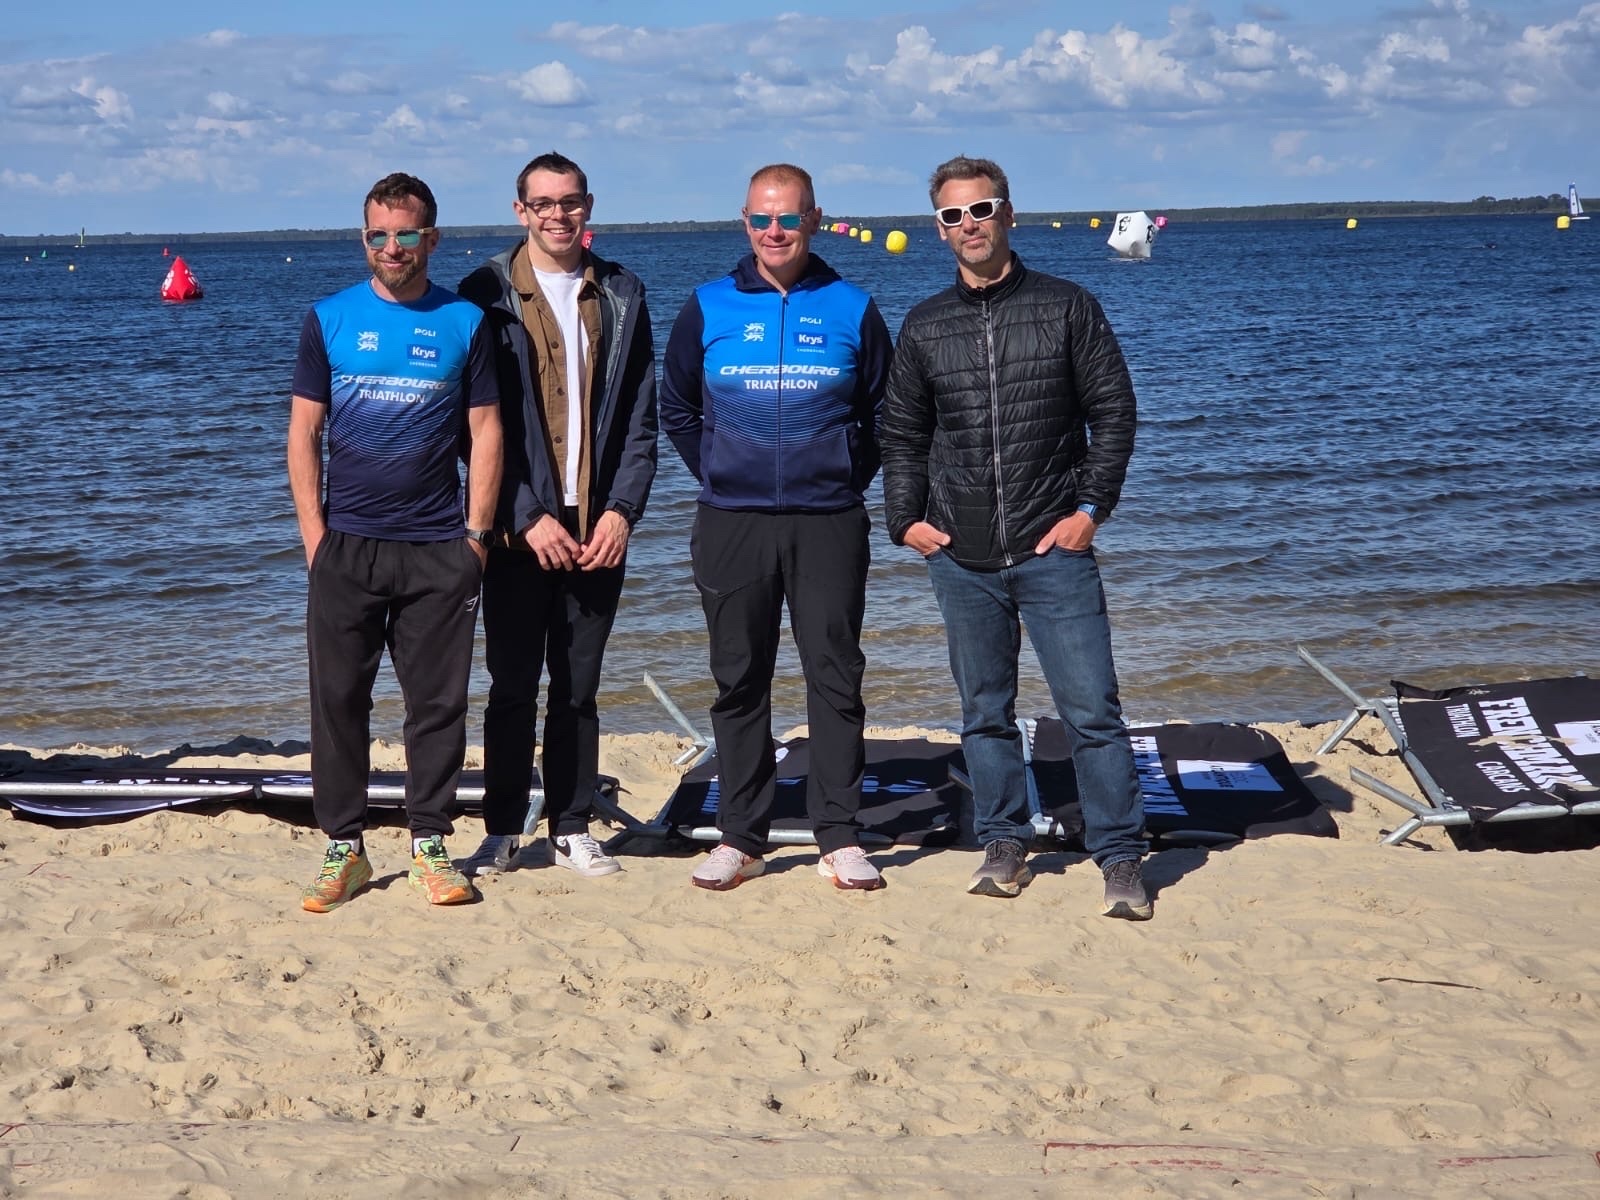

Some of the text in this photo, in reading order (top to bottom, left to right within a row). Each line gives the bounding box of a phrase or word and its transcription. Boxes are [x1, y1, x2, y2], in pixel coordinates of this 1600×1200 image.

[800, 316, 822, 325] POLI
[414, 328, 436, 337] POLI
[799, 334, 823, 345] Krys
[412, 346, 436, 358] Krys
[720, 364, 841, 376] CHERBOURG
[340, 374, 448, 390] CHERBOURG
[743, 379, 818, 390] TRIATHLON
[359, 388, 426, 404] TRIATHLON
[1444, 703, 1481, 738] TRIATHLON
[1475, 760, 1532, 793] CARCANS
